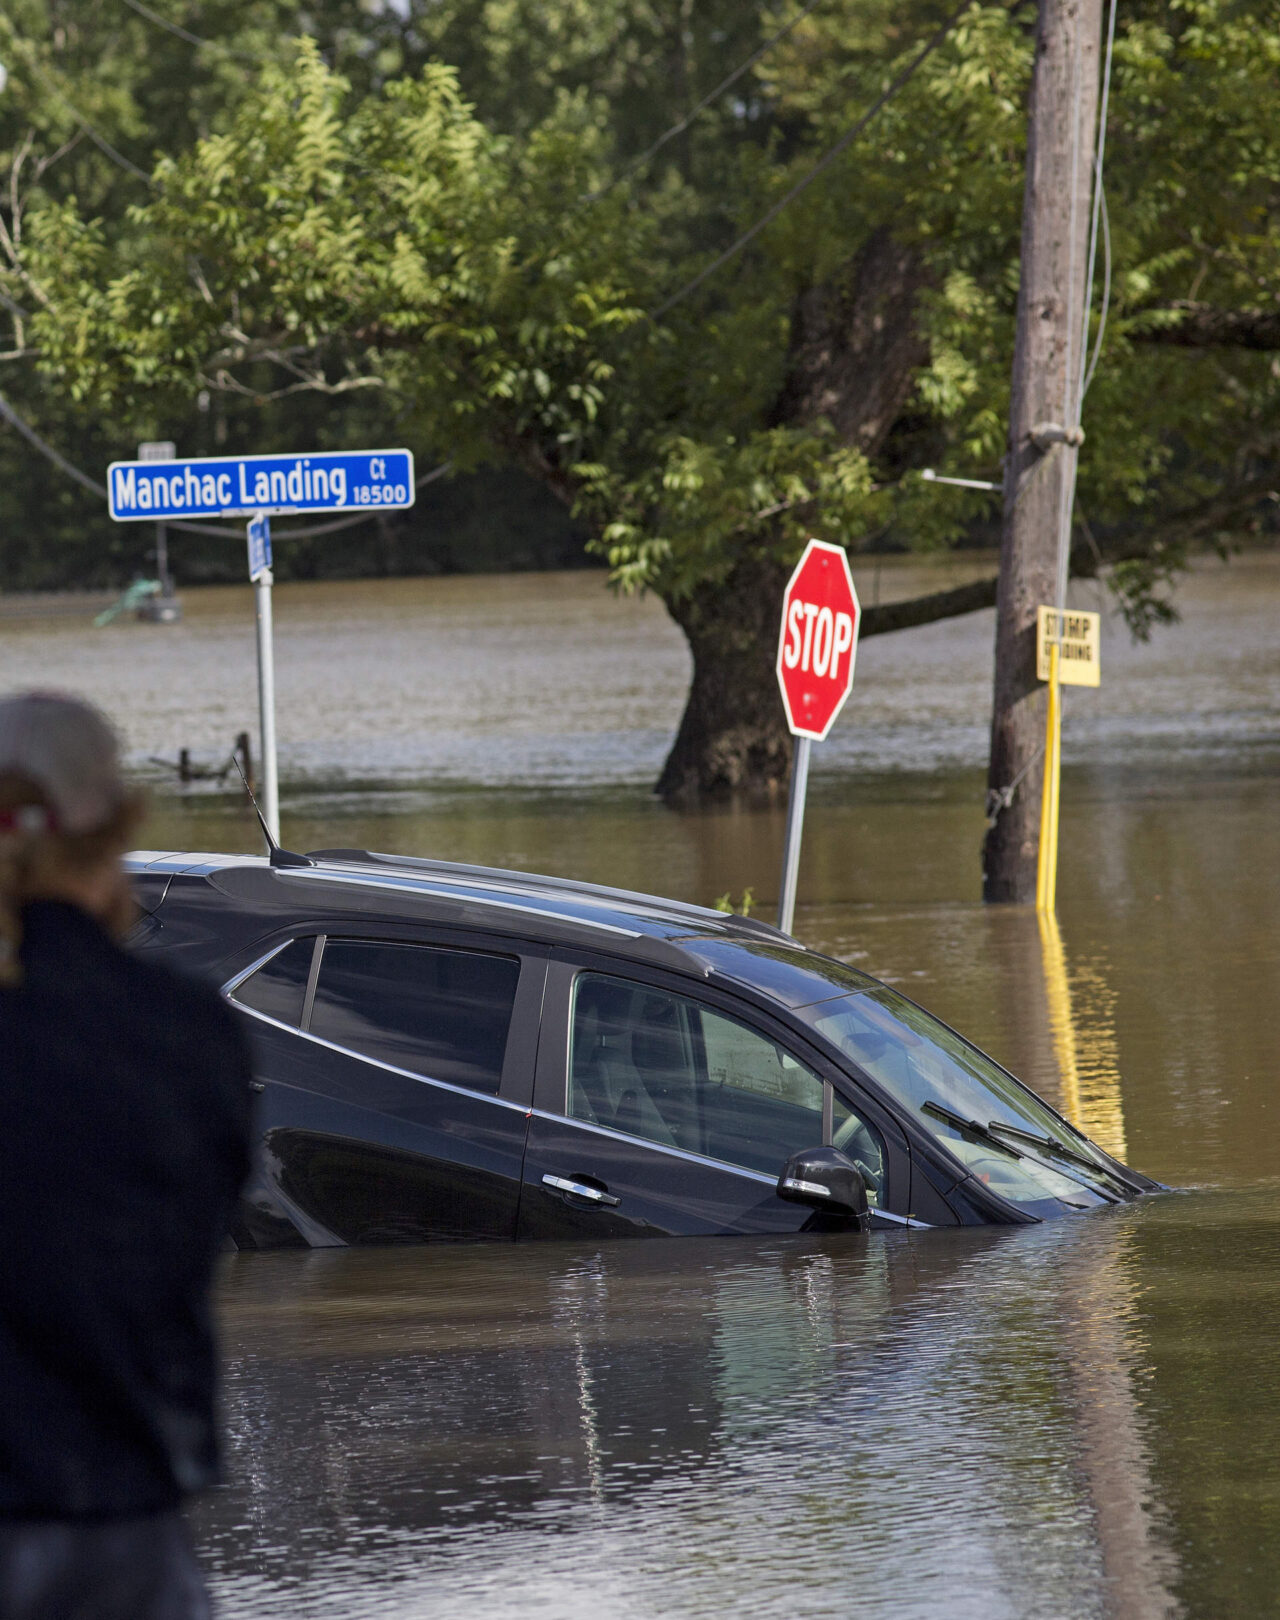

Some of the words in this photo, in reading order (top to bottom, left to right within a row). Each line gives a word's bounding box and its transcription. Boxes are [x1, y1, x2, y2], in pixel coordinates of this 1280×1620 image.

[115, 467, 232, 510] Manchac
[239, 460, 347, 506] Landing
[370, 458, 386, 479] Ct
[353, 484, 406, 504] 18500
[785, 599, 852, 679] STOP
